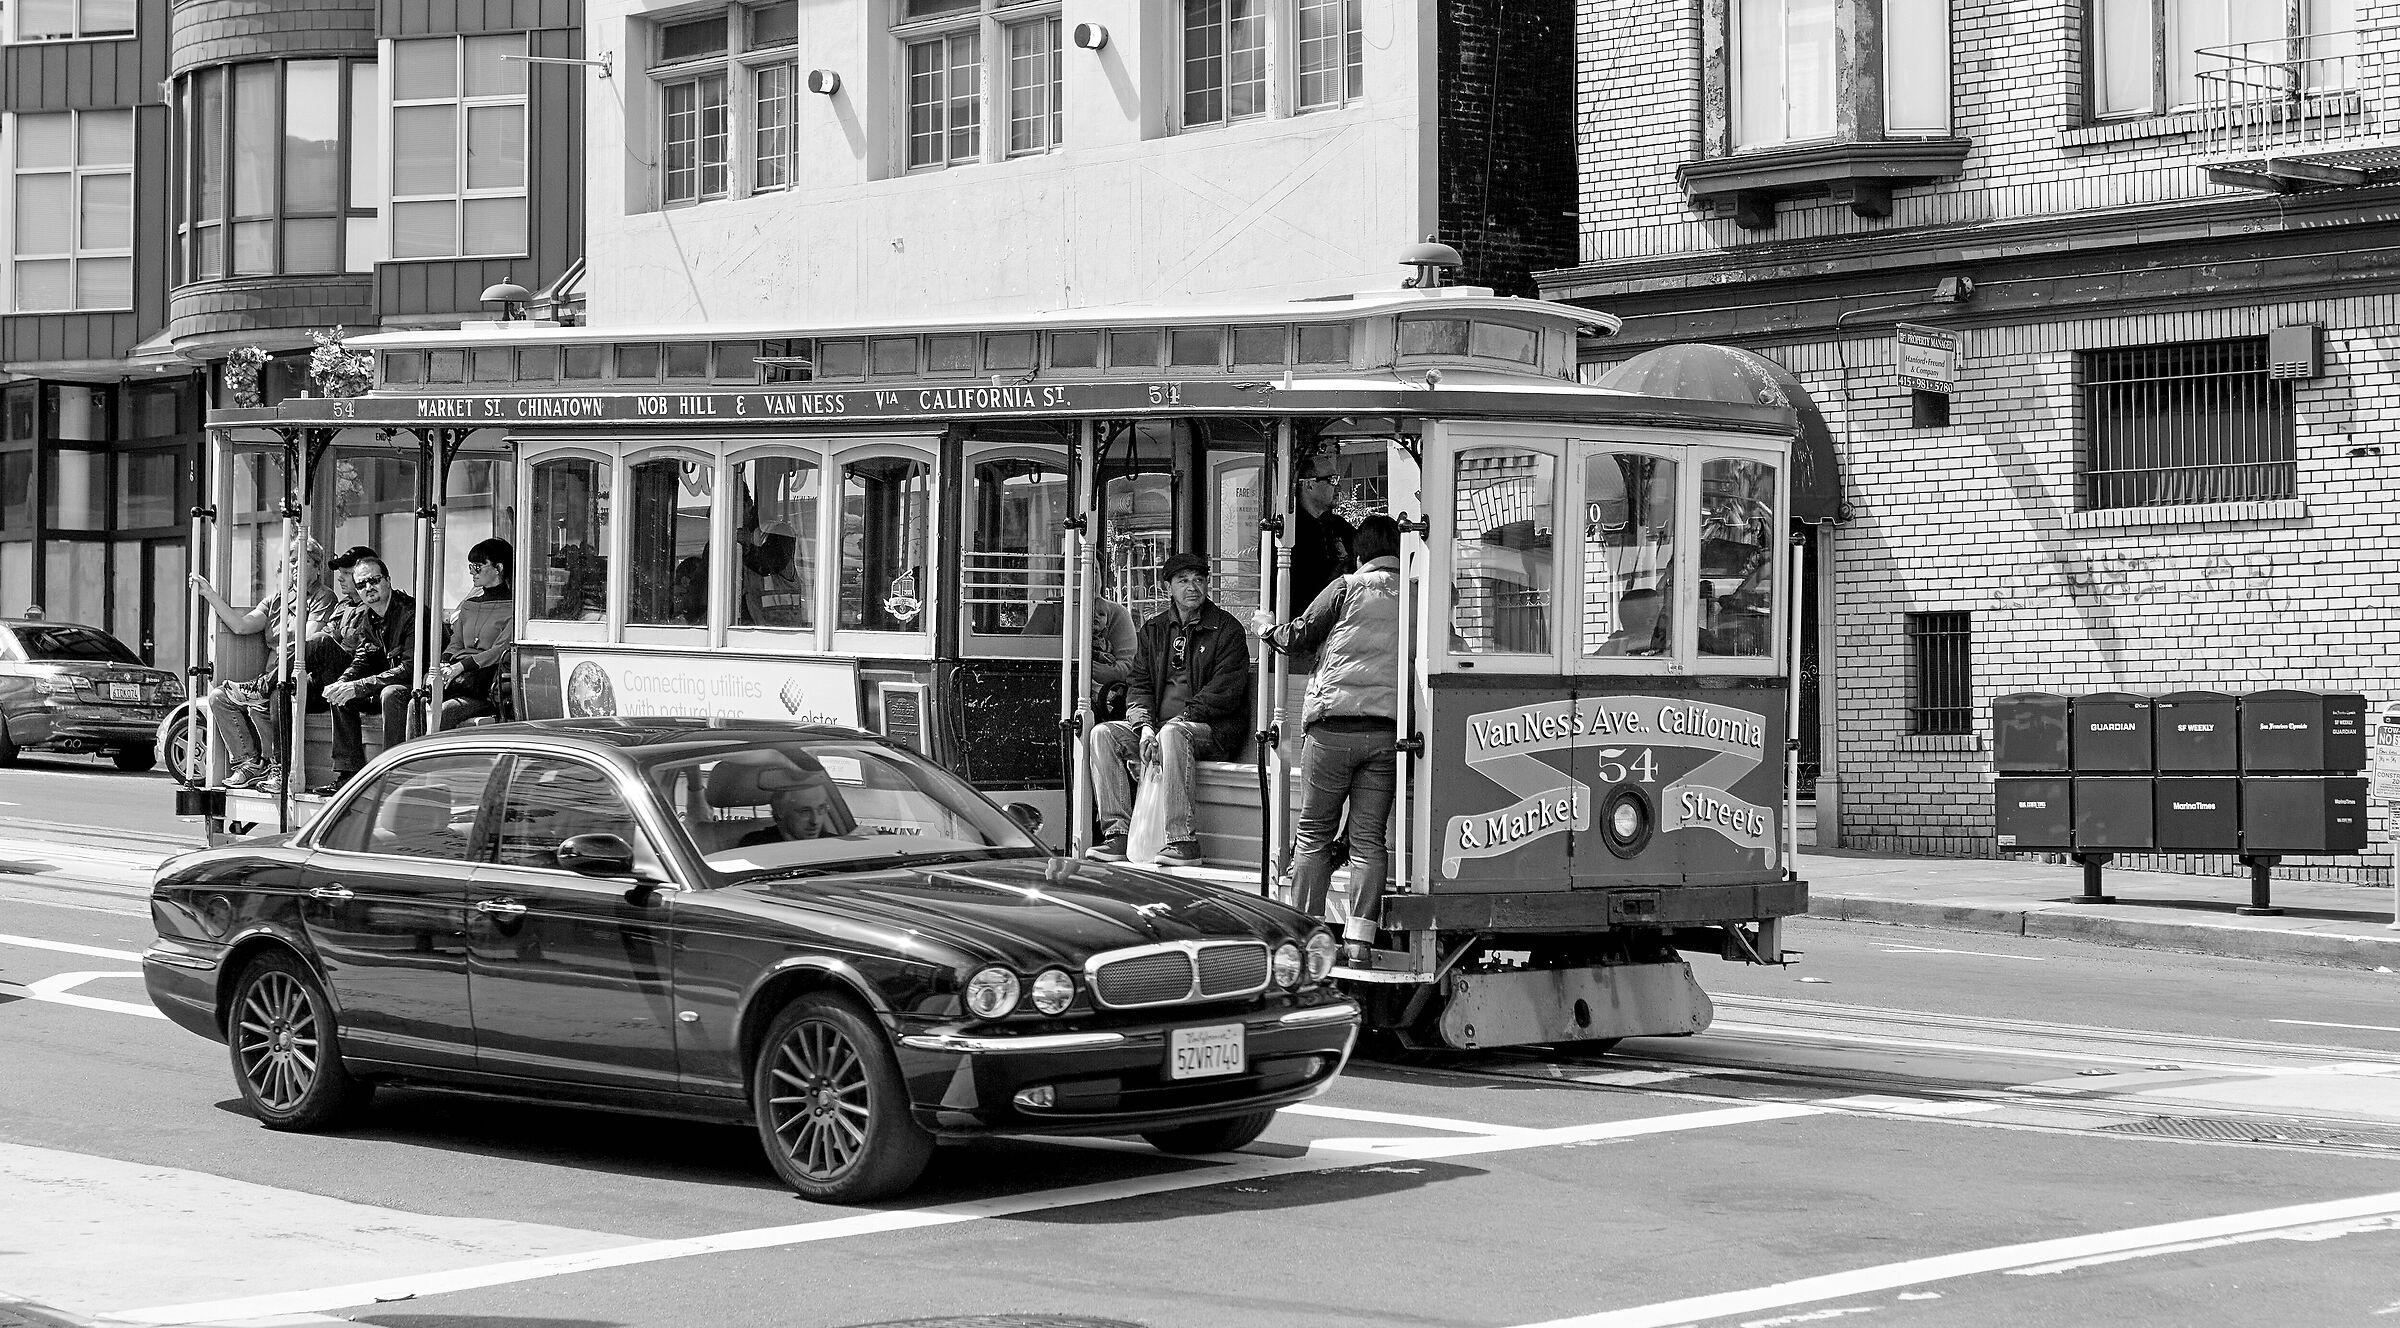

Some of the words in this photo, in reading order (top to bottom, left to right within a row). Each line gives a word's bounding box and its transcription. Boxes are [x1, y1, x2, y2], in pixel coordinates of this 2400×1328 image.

[1916, 366, 1939, 378] Company
[417, 398, 473, 417] MARKET
[517, 397, 603, 417] CHINATOWN
[637, 396, 668, 416] NOB
[680, 396, 717, 415] HILL
[735, 396, 746, 414] &
[764, 395, 797, 415] VAN
[802, 394, 845, 414] NESS
[919, 387, 1036, 410] CALIFORNIA
[1149, 386, 1180, 405] 54
[333, 401, 355, 418] 54
[1235, 487, 1250, 498] FARE
[1586, 503, 1601, 523] 0
[623, 669, 706, 701] Connecting
[711, 672, 762, 699] utilities
[624, 698, 655, 717] with
[1472, 720, 1520, 750] Van
[1523, 708, 1585, 742] Ness
[1658, 705, 1762, 749] California
[2090, 723, 2136, 732] GUARDIAN
[2177, 724, 2187, 732] SF
[2187, 724, 2214, 732] WEEKLY
[2379, 733, 2392, 745] NO
[1599, 747, 1659, 783] 54
[1460, 819, 1482, 849] &
[1485, 791, 1580, 847] Market
[1680, 790, 1766, 837] Streets
[1178, 1043, 1240, 1070] 5ZVR740
